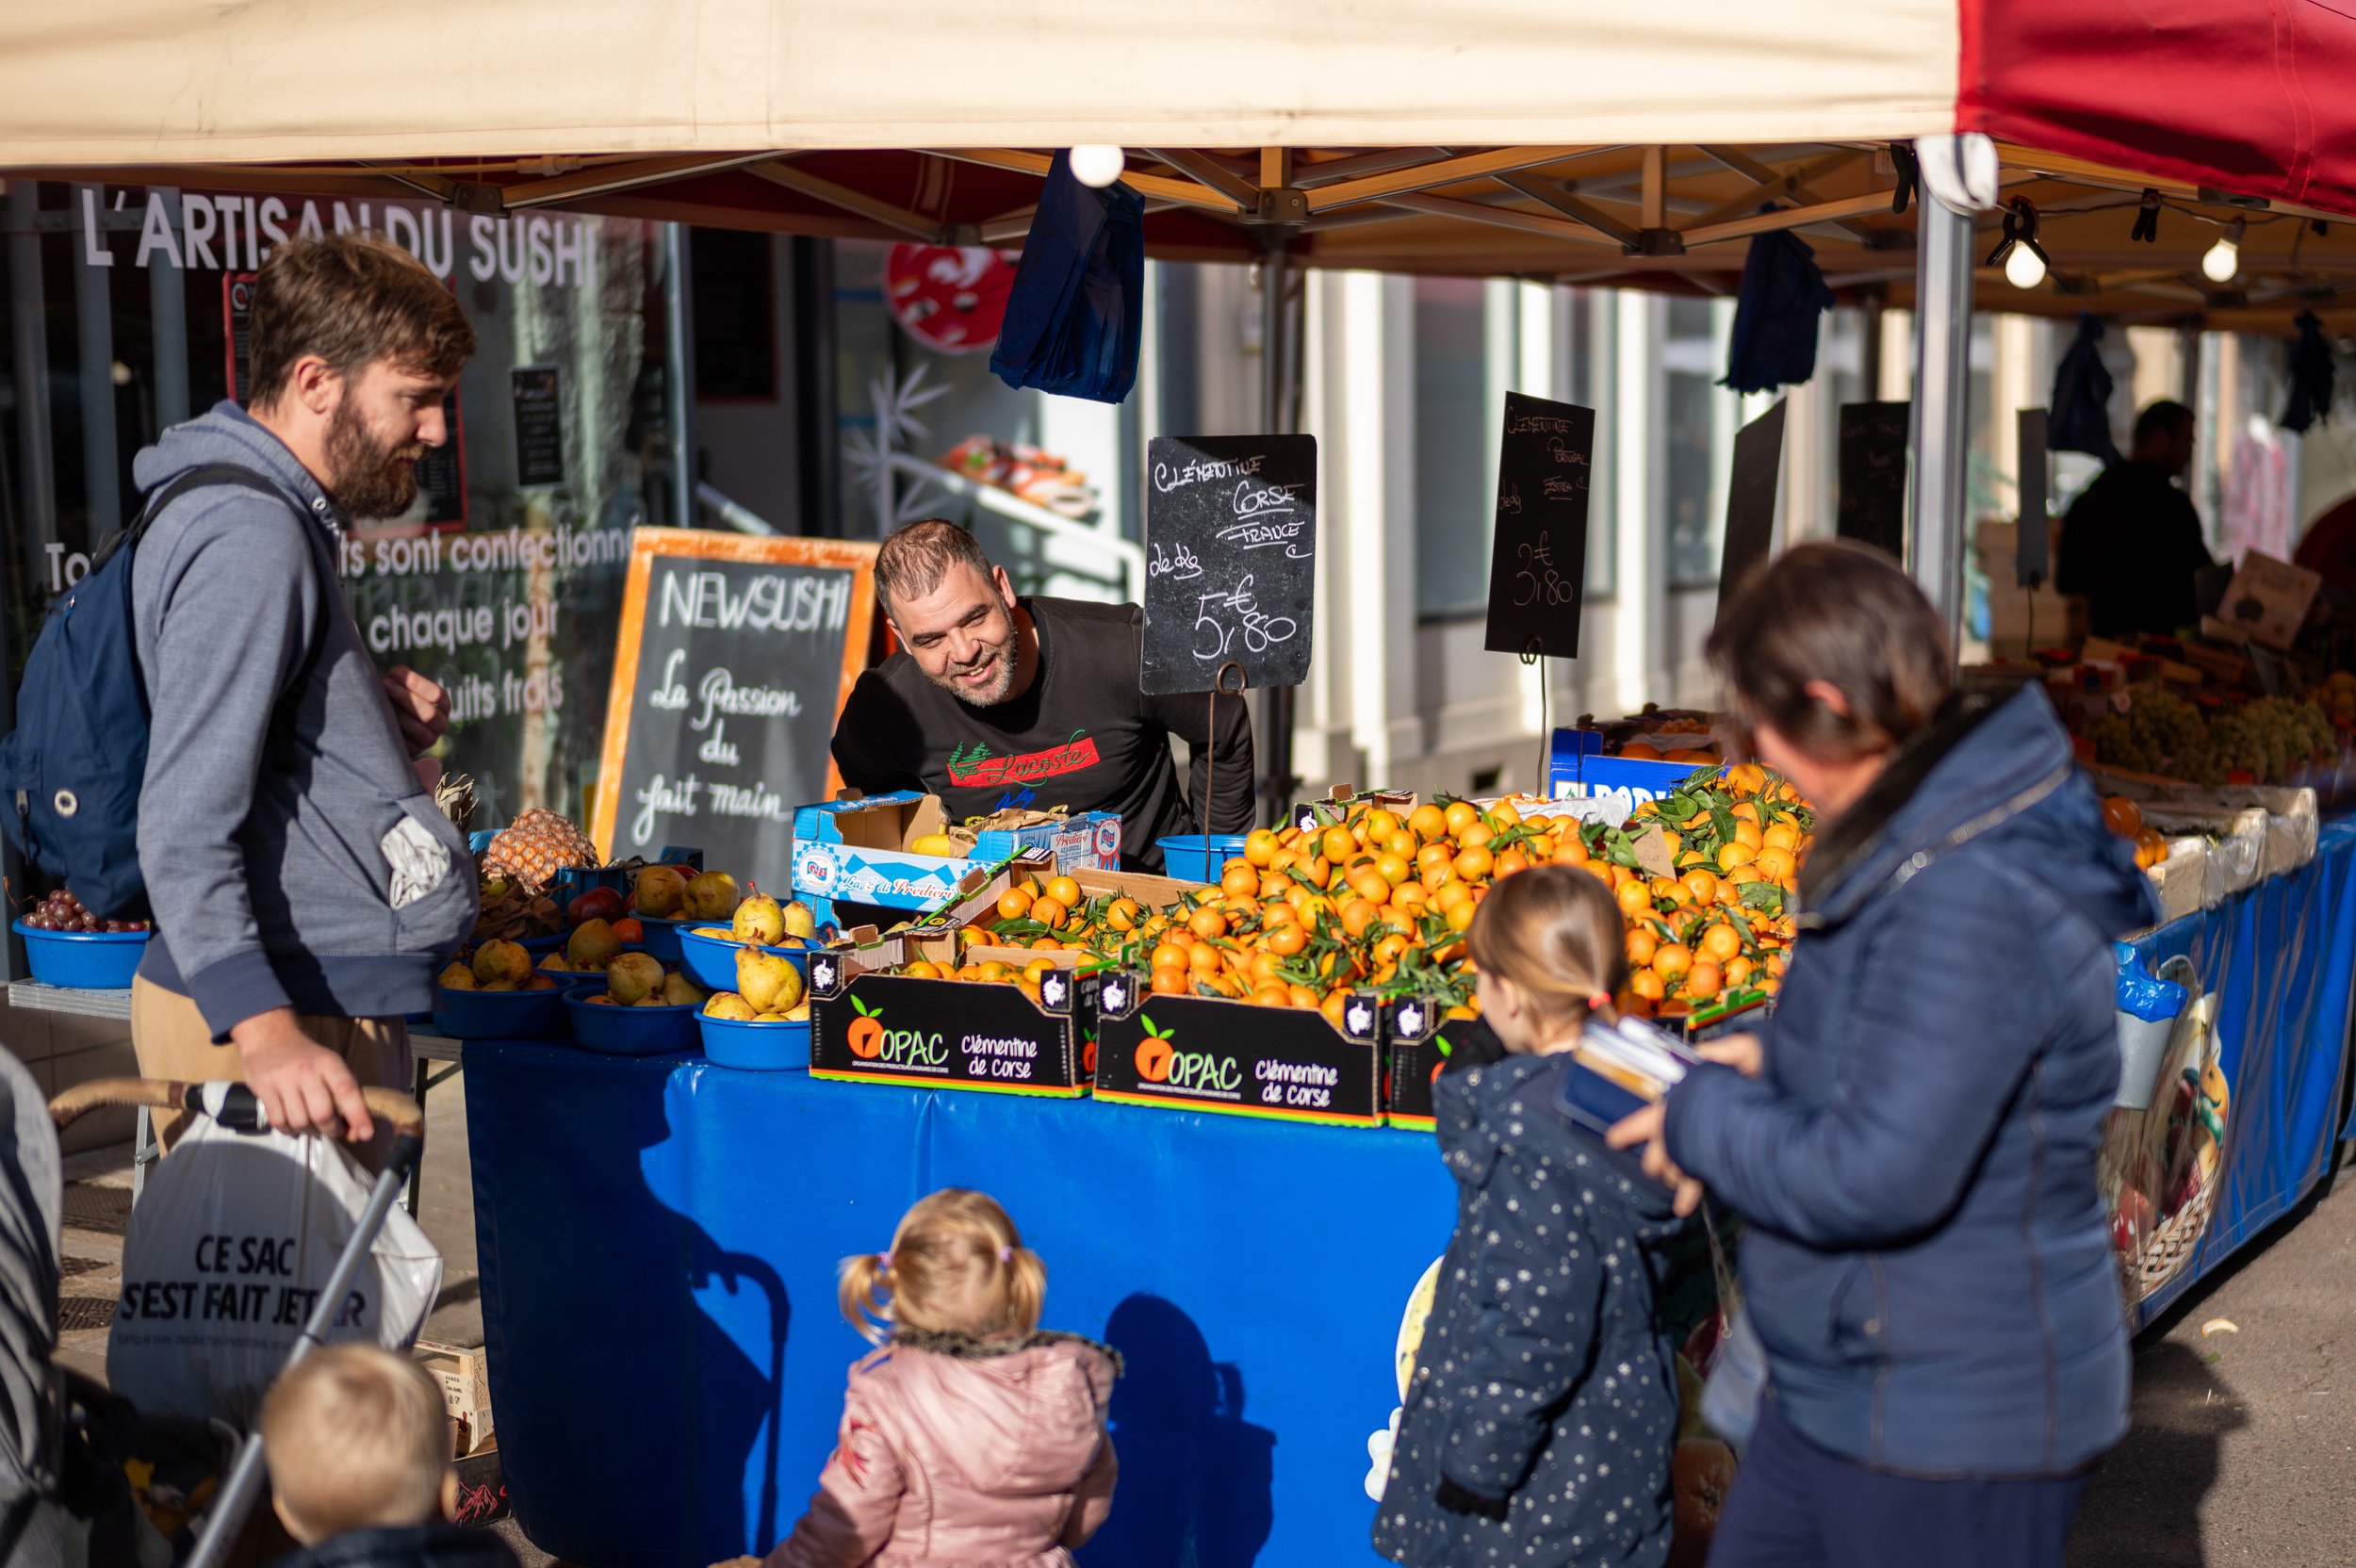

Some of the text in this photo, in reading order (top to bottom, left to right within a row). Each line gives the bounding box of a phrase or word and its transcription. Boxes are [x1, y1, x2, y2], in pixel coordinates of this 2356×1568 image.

[82, 188, 597, 287] L'ARTISAN DU SUSHI
[1233, 481, 1305, 514] CORSE
[375, 528, 442, 576] sont
[1216, 521, 1305, 543] FRANCE
[369, 596, 559, 655] chaque jour
[503, 668, 564, 715] frais
[648, 647, 689, 710] La
[698, 718, 740, 765] du
[986, 729, 1091, 787] Lacoste
[630, 773, 794, 846] fait main
[893, 878, 956, 901] Predieri
[879, 1029, 949, 1066] OPAC
[961, 1034, 1038, 1058] Clémentine
[968, 1055, 1032, 1079] de Corse
[1168, 1051, 1242, 1091] OPAC
[1255, 1059, 1339, 1086] Clémentine
[1262, 1082, 1283, 1103] de
[1286, 1086, 1331, 1107] Corse
[195, 1234, 296, 1276] CE SAC
[203, 1282, 270, 1322] FAIT
[272, 1286, 366, 1328] JETR
